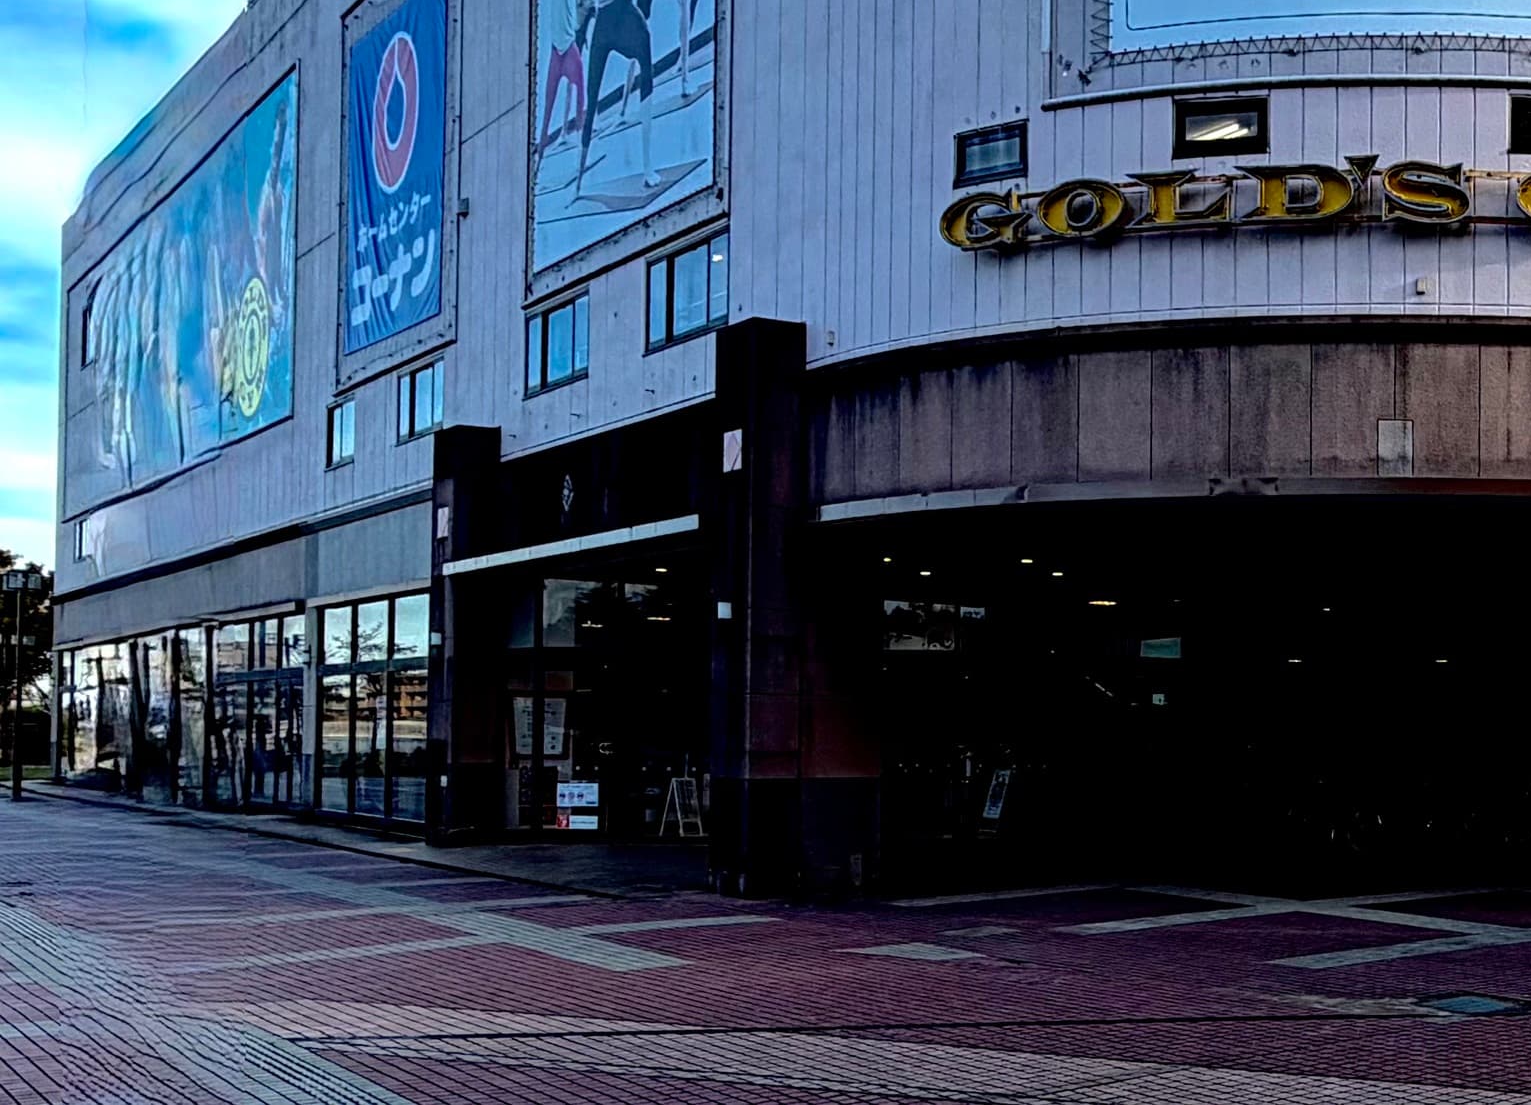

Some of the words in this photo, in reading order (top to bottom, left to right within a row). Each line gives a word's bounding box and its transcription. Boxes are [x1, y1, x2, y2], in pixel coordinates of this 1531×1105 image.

[357, 191, 432, 252] ホームセンター
[939, 152, 1476, 251] GOLD'S
[350, 228, 435, 327] コーナン
